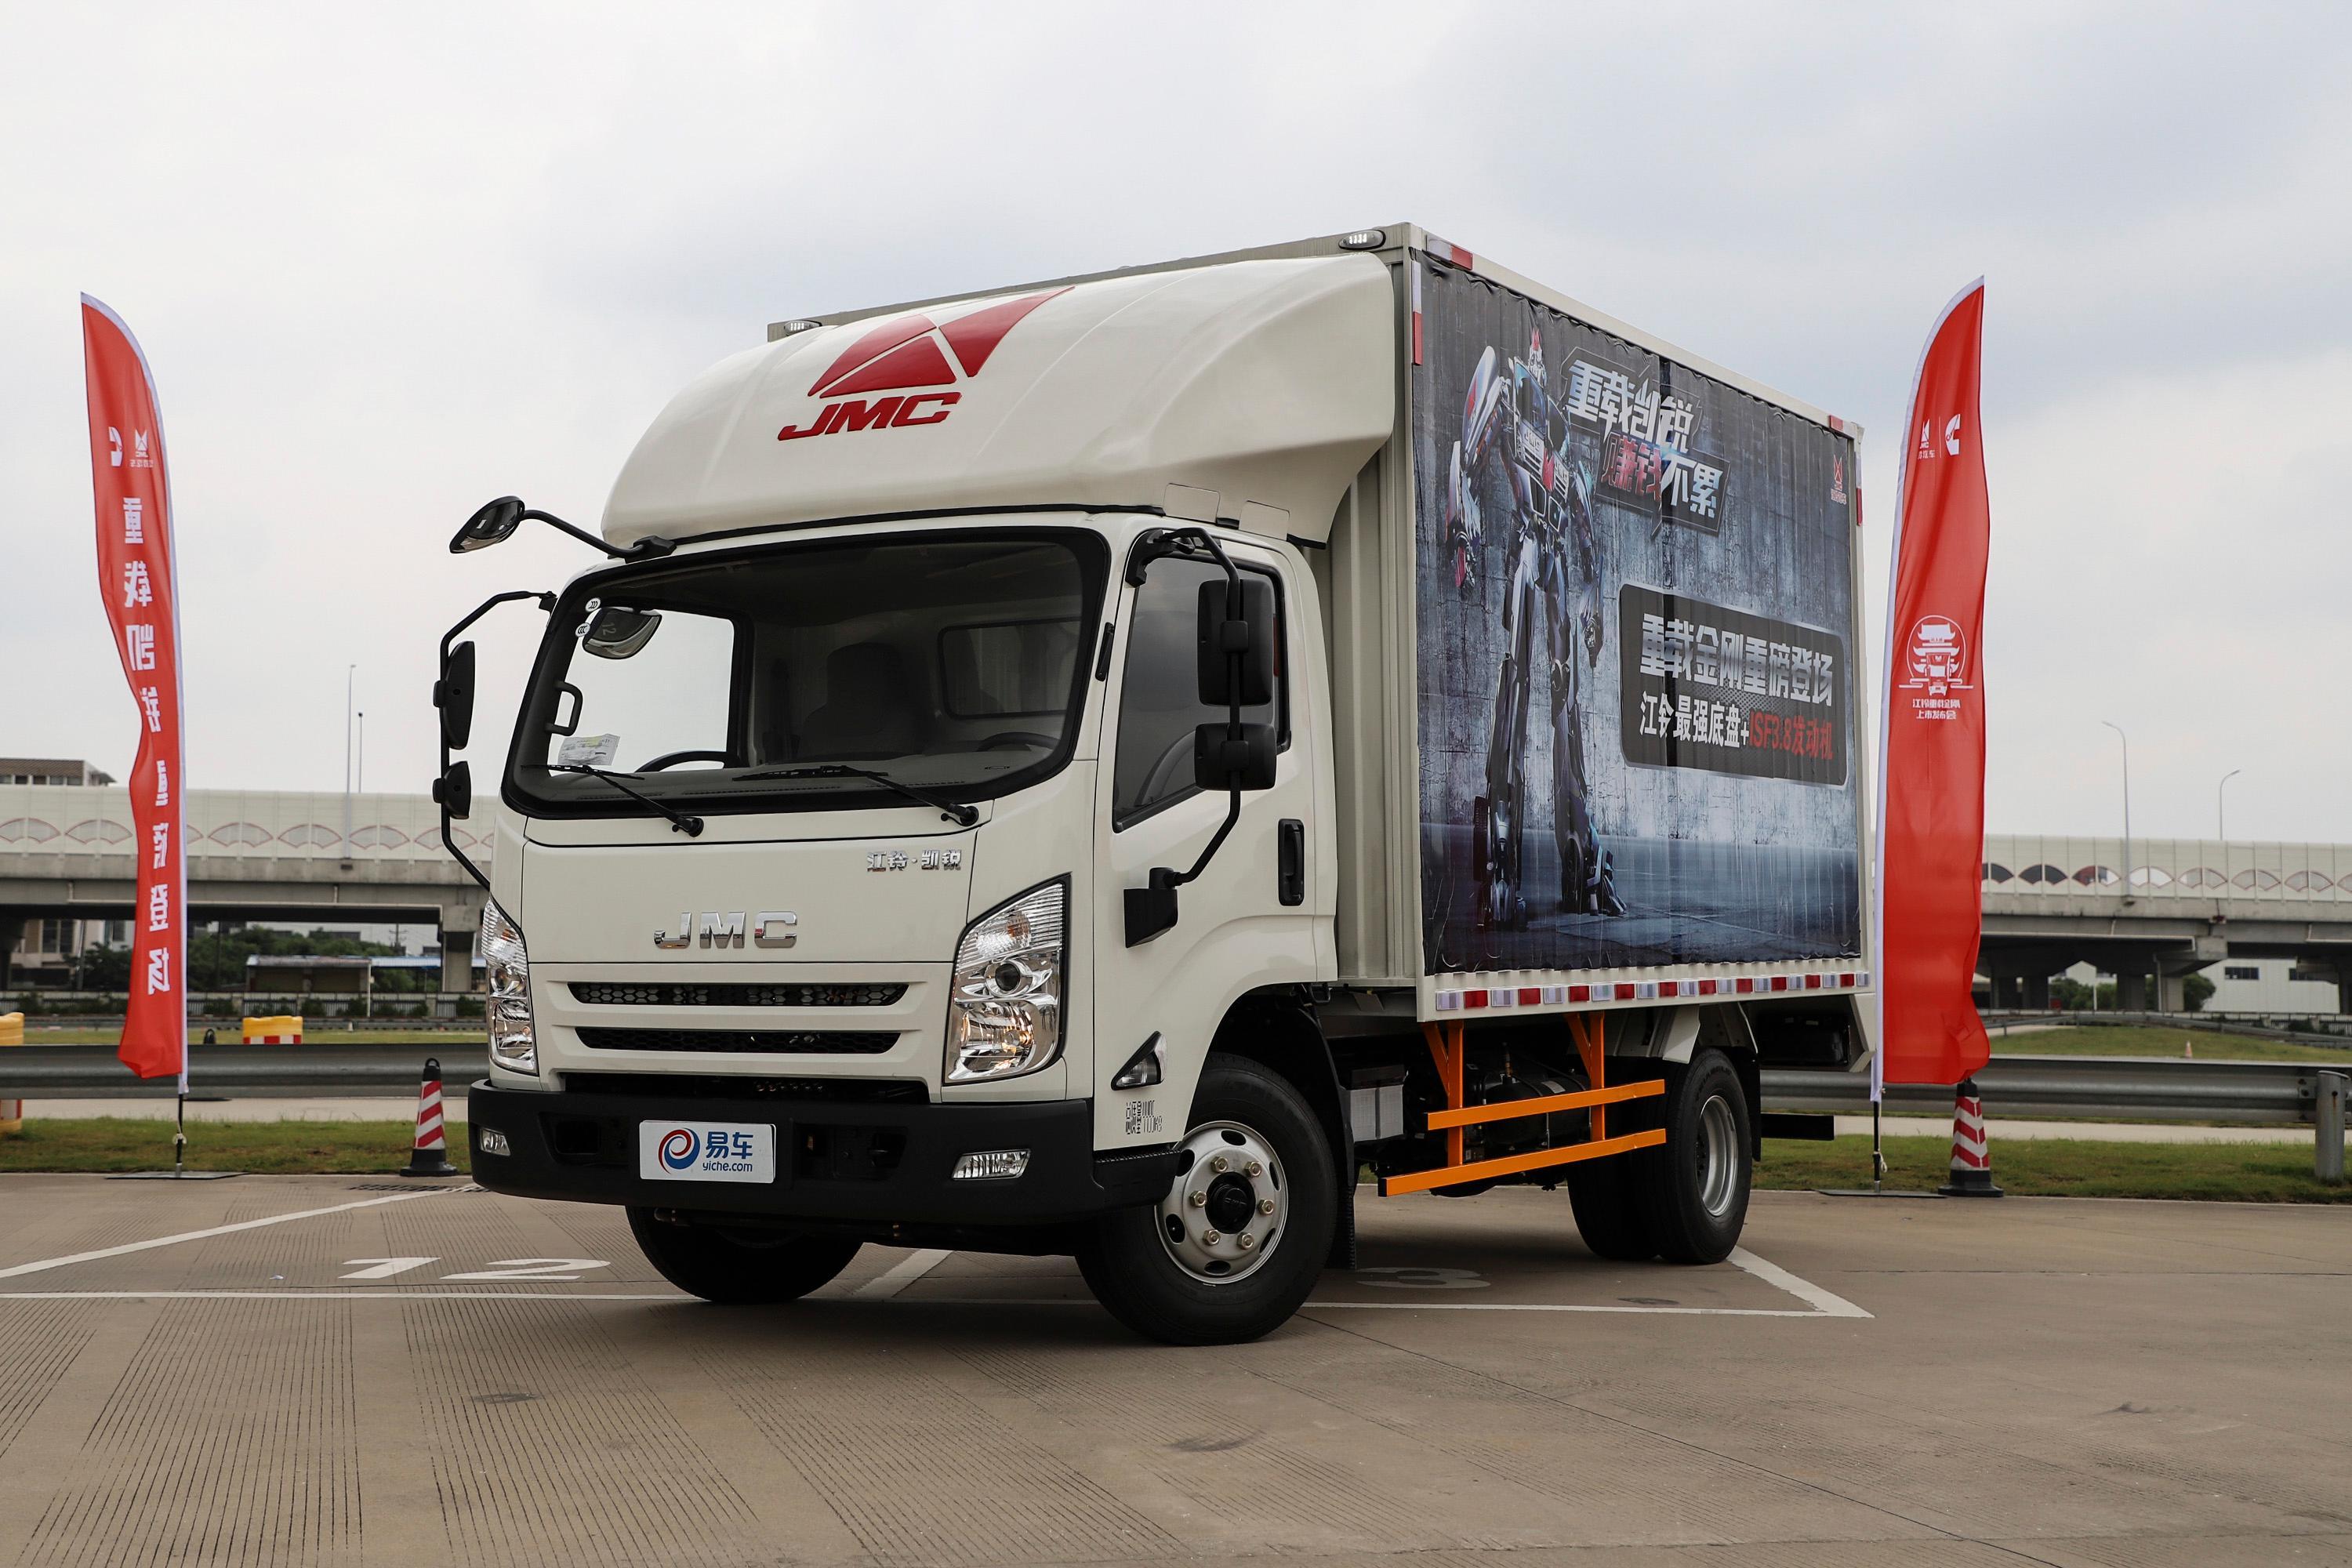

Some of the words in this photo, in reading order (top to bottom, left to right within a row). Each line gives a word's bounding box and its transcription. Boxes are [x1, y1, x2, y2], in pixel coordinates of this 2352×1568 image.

[778, 392, 962, 441] JMC
[1566, 359, 1694, 453] 重载凯锐
[1601, 431, 1723, 518] 赚钱不累
[1640, 613, 1833, 706] 重载金刚重磅登场
[654, 910, 798, 949] JMC
[702, 1160, 753, 1173] yiche.com
[706, 1131, 753, 1159] 易车
